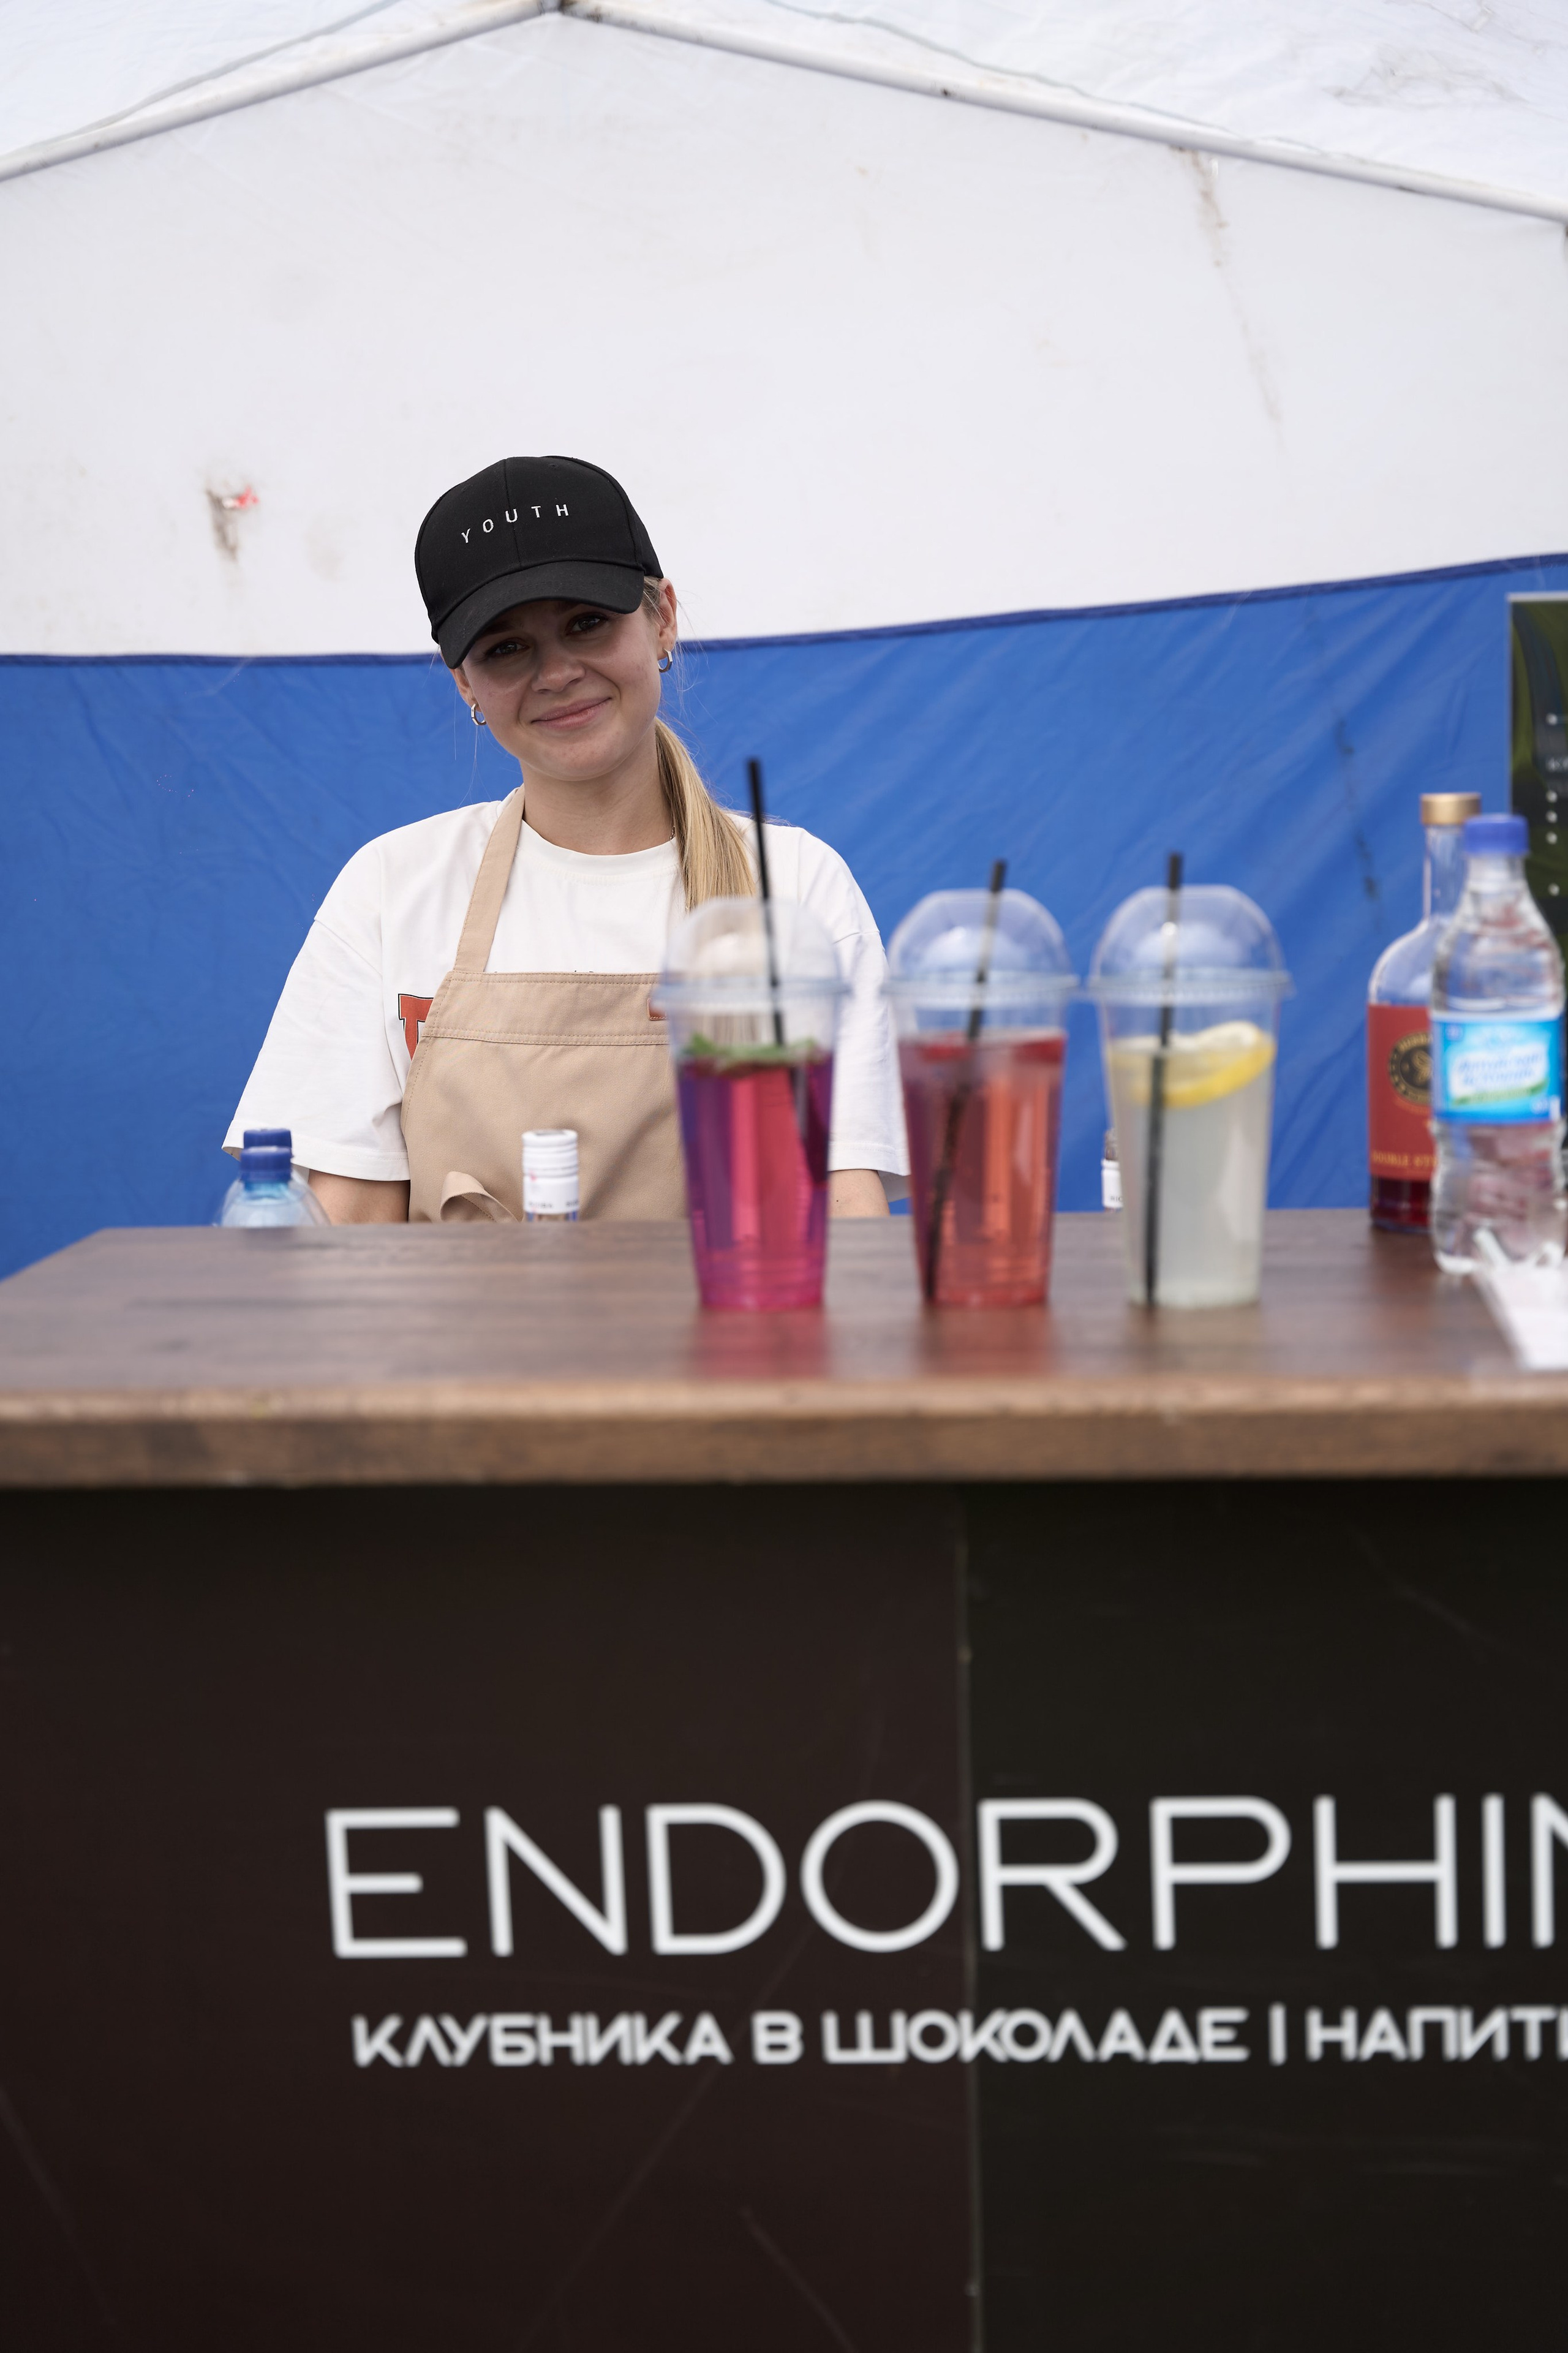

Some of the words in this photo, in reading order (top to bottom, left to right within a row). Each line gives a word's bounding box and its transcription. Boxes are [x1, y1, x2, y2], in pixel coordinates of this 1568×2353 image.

[461, 504, 569, 543] YOUTH
[326, 1792, 1568, 1958] ENDORPHI
[352, 2012, 733, 2068] КЛУБНИКА
[752, 2010, 803, 2065] В
[822, 2007, 1250, 2065] ШОКОЛАДЕ
[1306, 2006, 1568, 2062] НАПИТ
